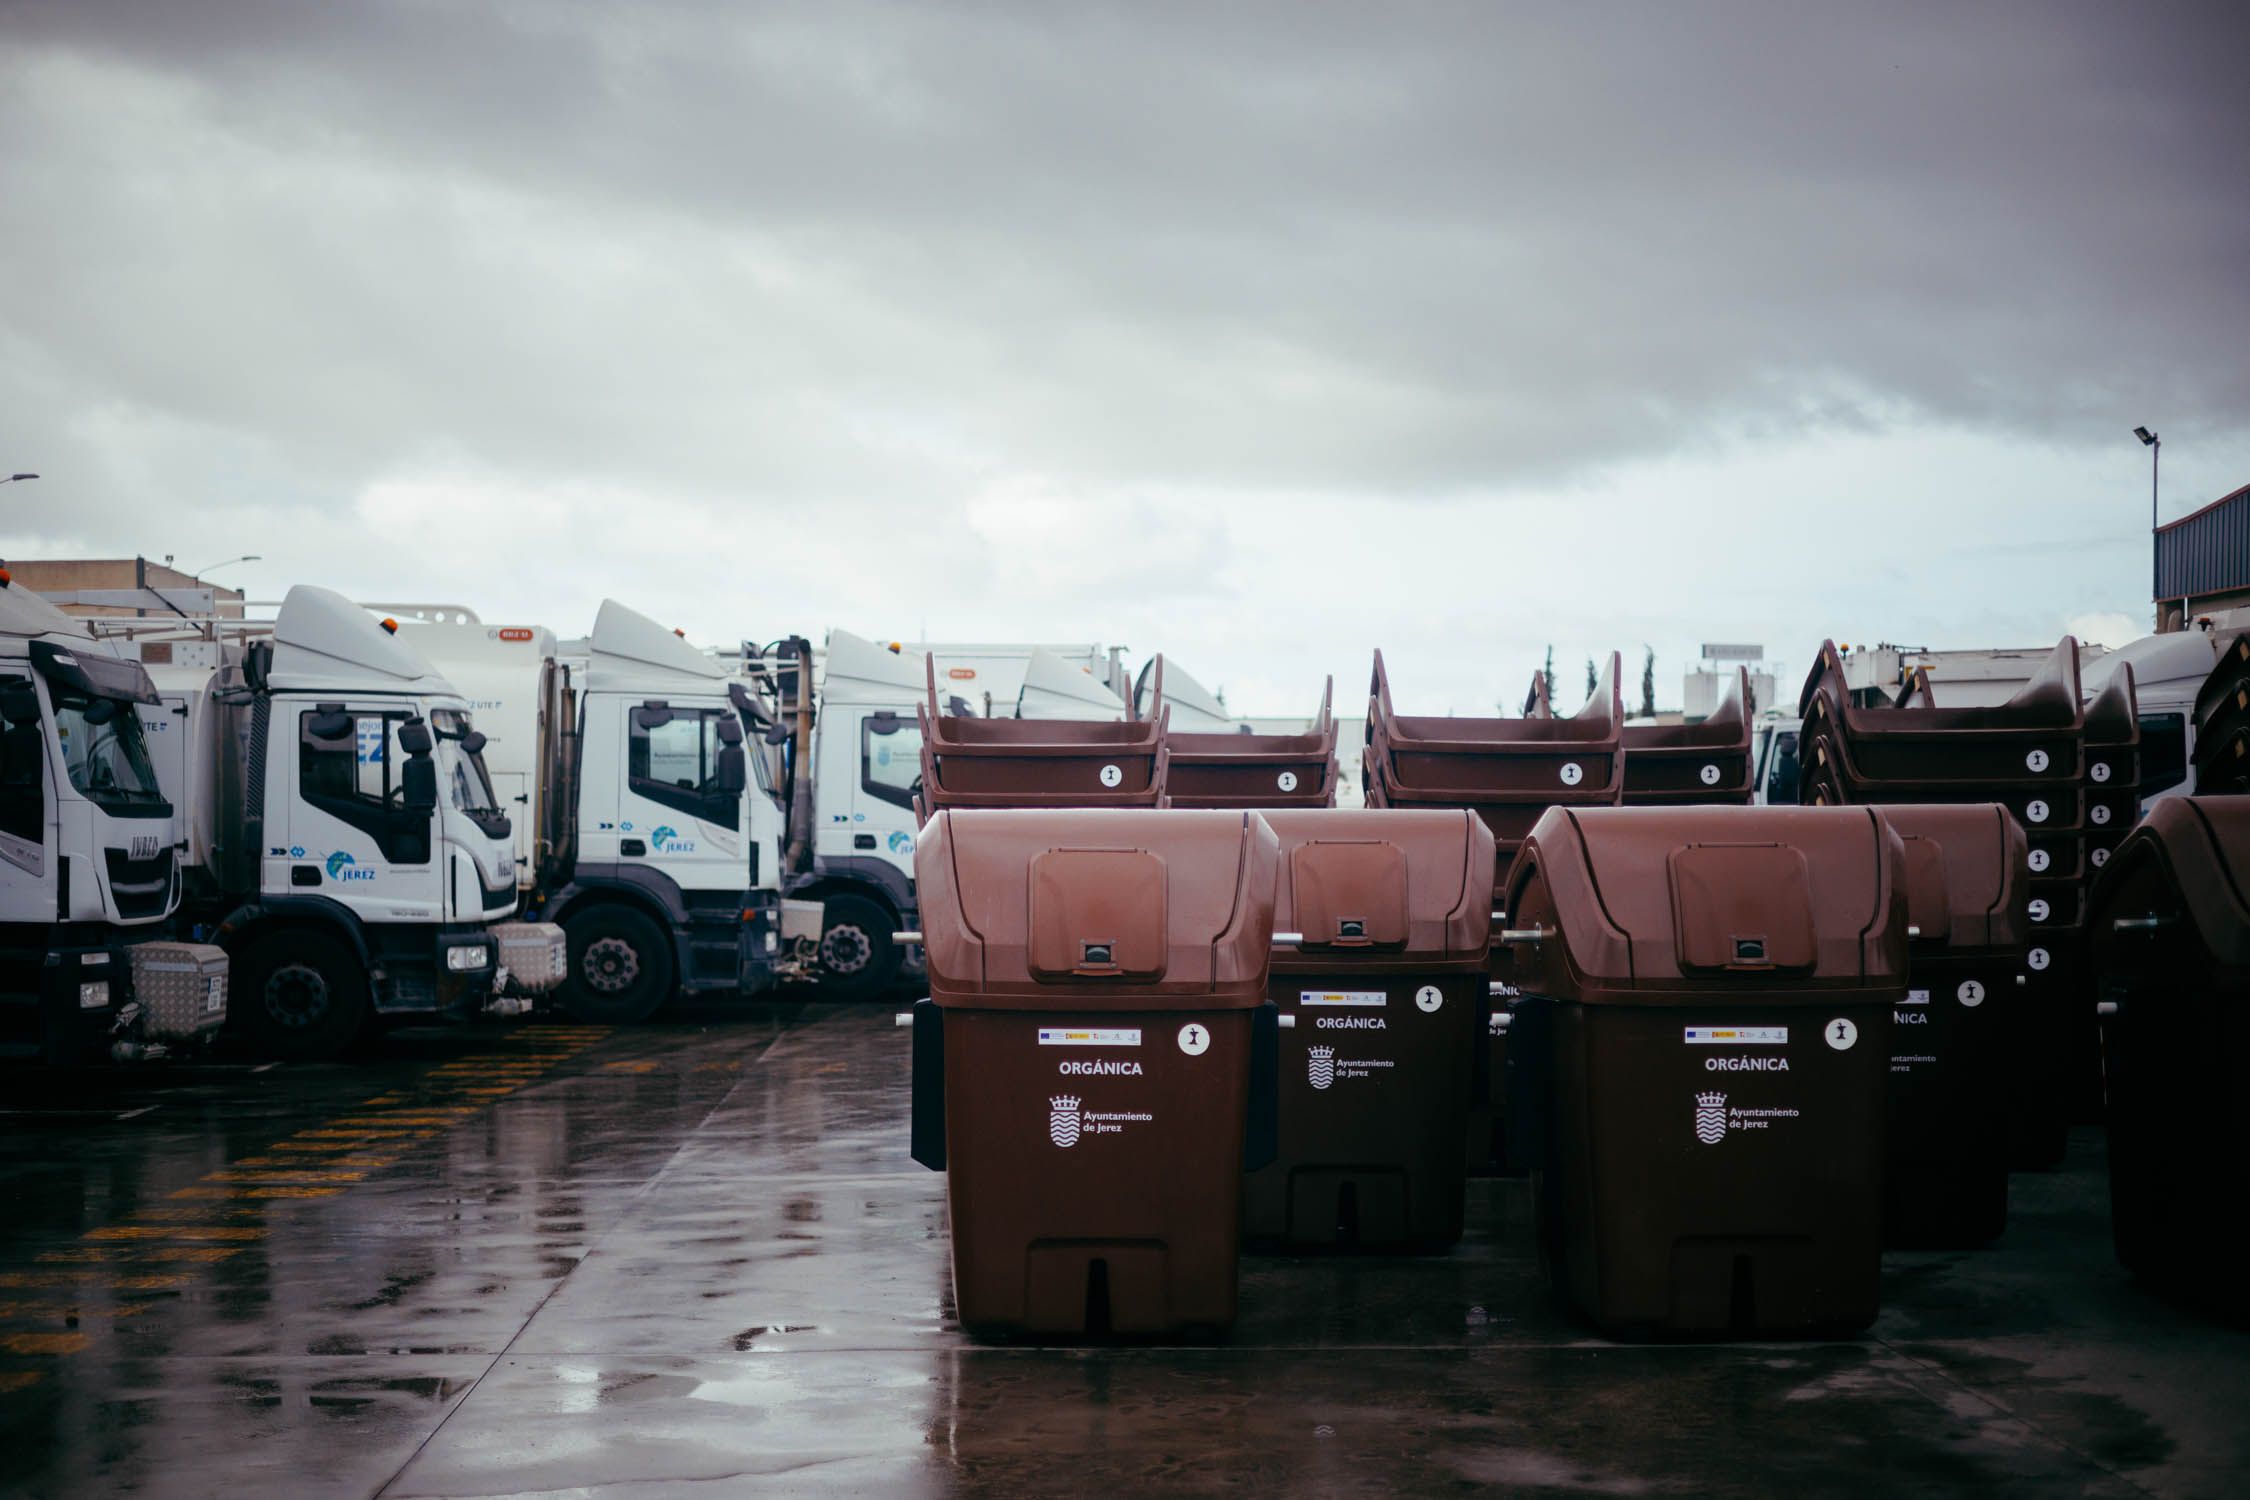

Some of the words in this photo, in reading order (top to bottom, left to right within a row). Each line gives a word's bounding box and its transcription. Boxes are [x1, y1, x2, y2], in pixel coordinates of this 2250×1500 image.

[343, 870, 376, 882] JEREZ
[1316, 1015, 1386, 1029] ORGÁNICA
[1059, 1059, 1143, 1075] ORGÁNICA
[1336, 1059, 1394, 1068] Ayuntamiento
[1705, 1055, 1789, 1070] ORGÁNICA
[1336, 1069, 1346, 1077] de
[1347, 1069, 1369, 1078] Jerez
[1083, 1111, 1153, 1122] Ayuntamiento
[1729, 1107, 1799, 1118] Ayuntamiento
[1083, 1123, 1095, 1132] de
[1096, 1123, 1122, 1134] Jerez
[1729, 1119, 1741, 1128] de
[1742, 1119, 1768, 1130] Jerez
